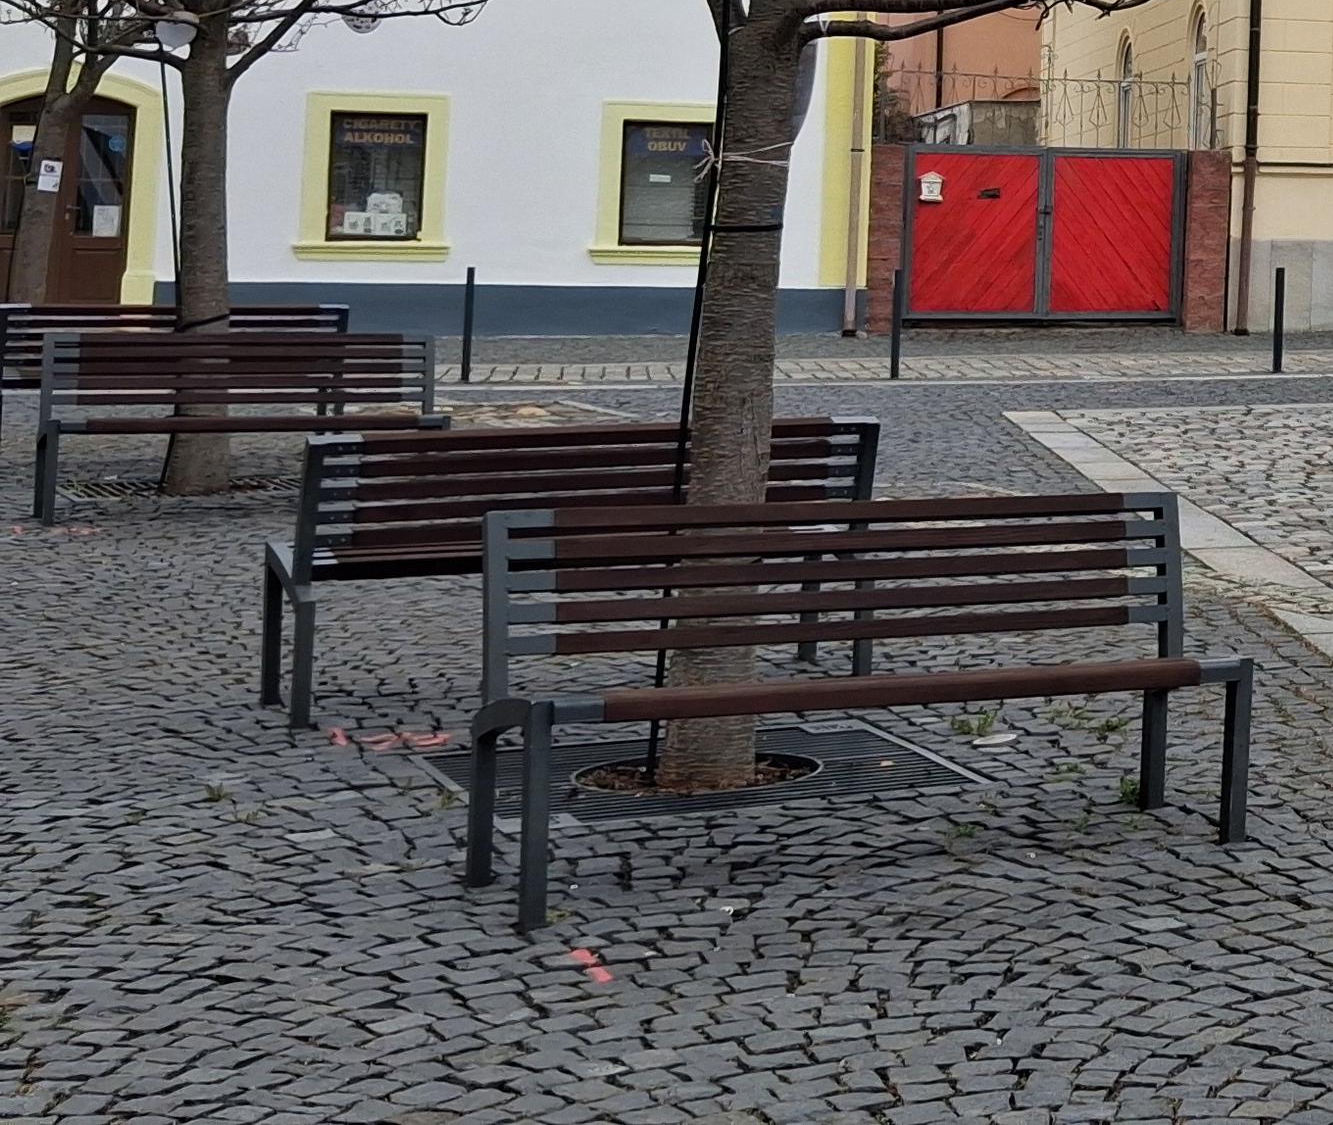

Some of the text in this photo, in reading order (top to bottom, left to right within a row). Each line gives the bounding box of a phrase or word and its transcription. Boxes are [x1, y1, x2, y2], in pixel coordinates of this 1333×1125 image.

[343, 119, 421, 130] CIGARETY
[344, 132, 414, 144] ALKOHOL
[647, 141, 687, 151] OBUV
